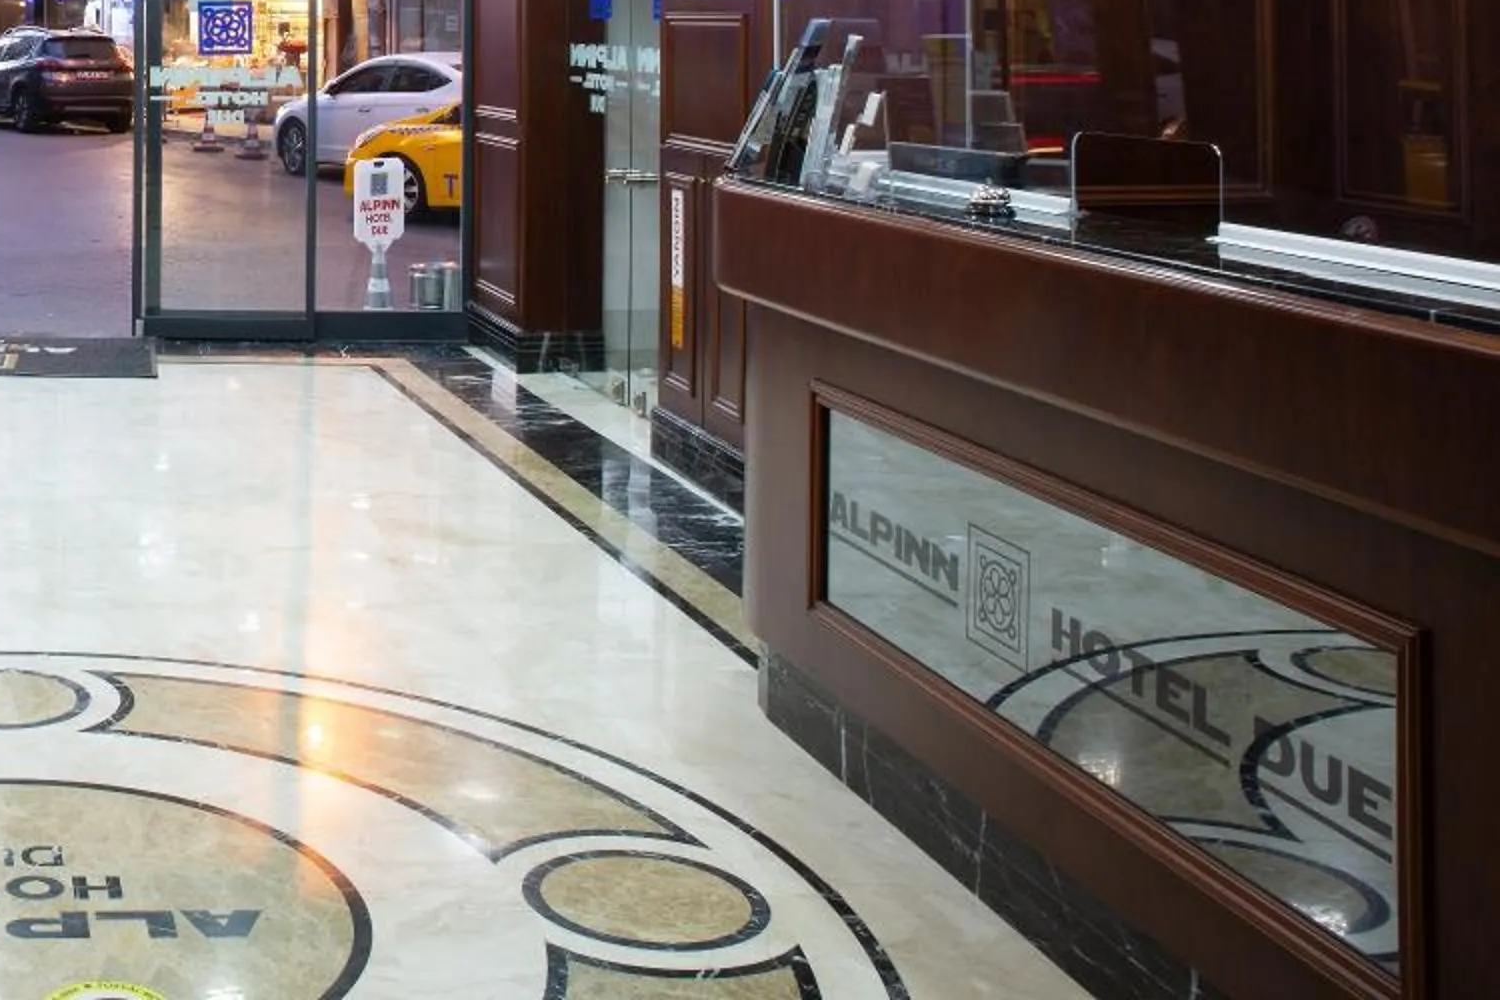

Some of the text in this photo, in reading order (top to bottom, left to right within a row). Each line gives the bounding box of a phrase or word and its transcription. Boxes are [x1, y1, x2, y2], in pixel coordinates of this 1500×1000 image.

[359, 199, 401, 213] ALPINN
[829, 491, 1394, 841] ALPINN HOTEL DUE
